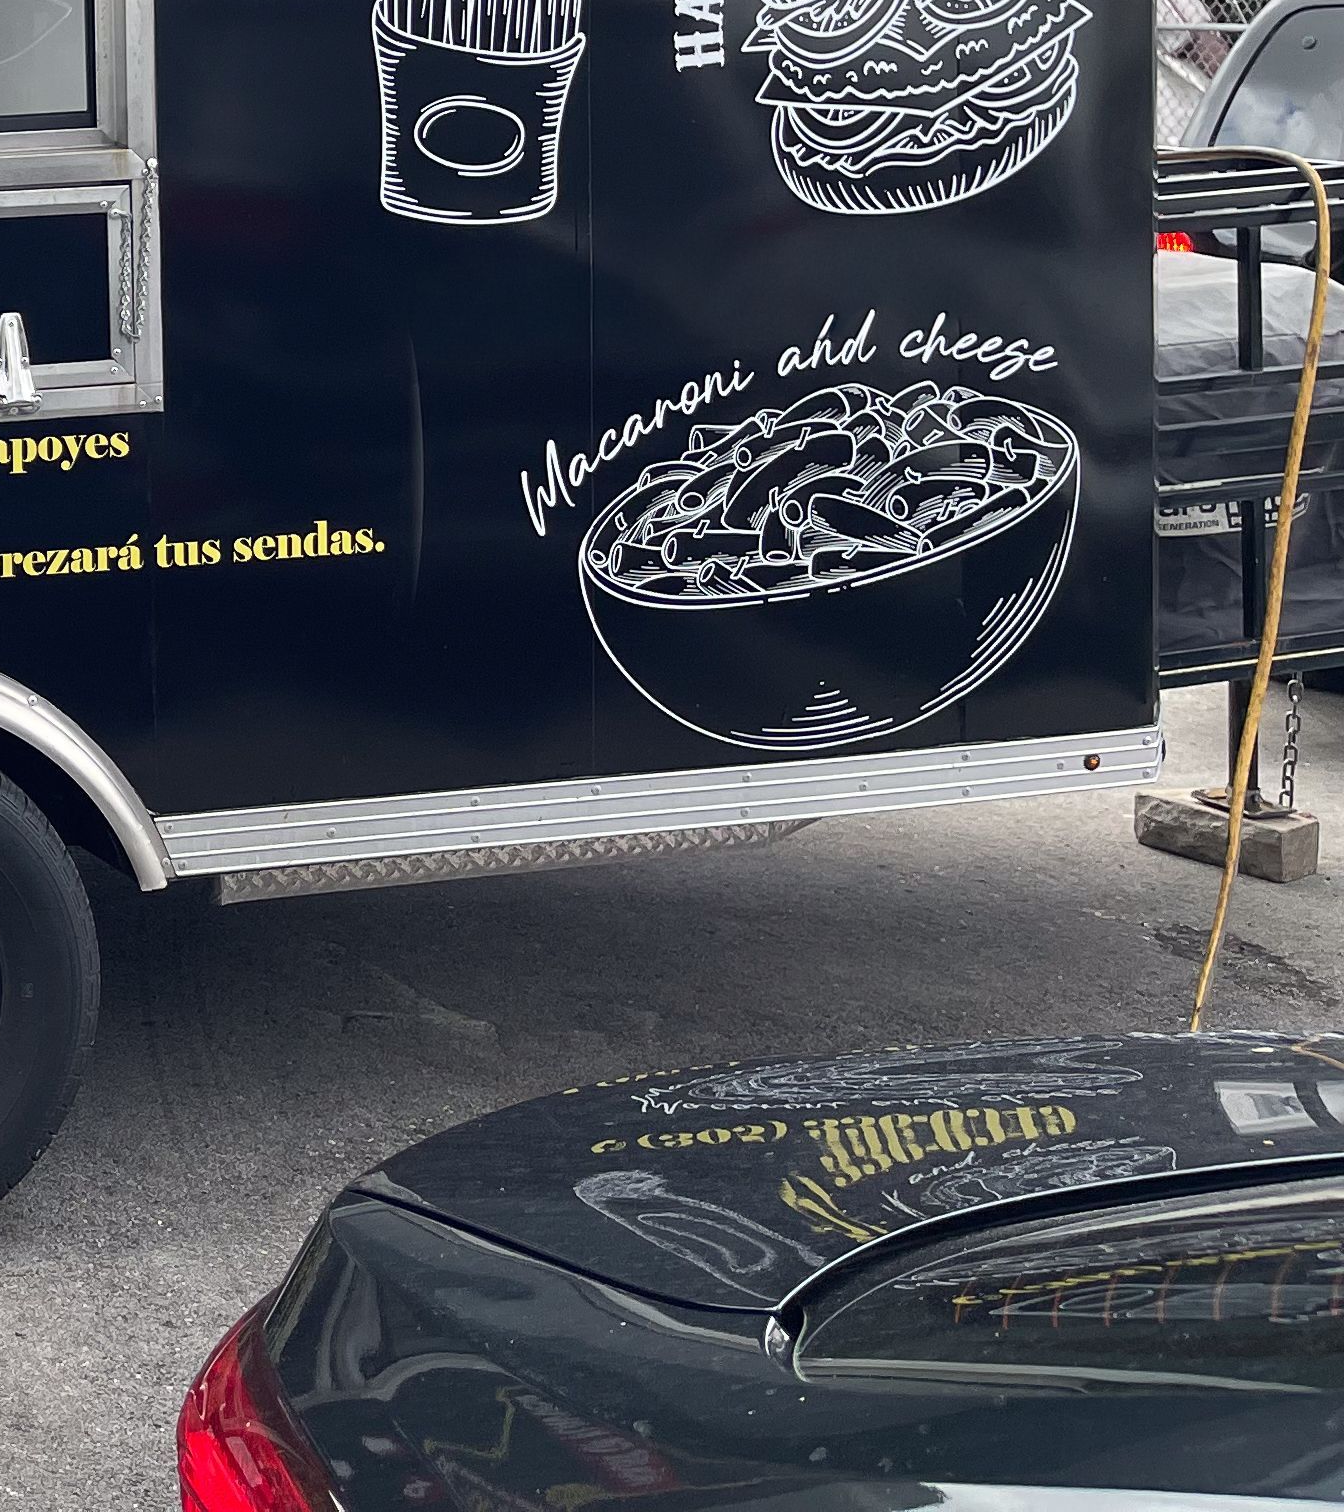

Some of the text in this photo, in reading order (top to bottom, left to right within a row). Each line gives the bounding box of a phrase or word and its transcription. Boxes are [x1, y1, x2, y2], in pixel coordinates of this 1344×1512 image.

[520, 359, 757, 537] Macaroni
[899, 312, 1059, 381] cheese
[155, 535, 222, 568] tus
[233, 520, 385, 562] sendas.
